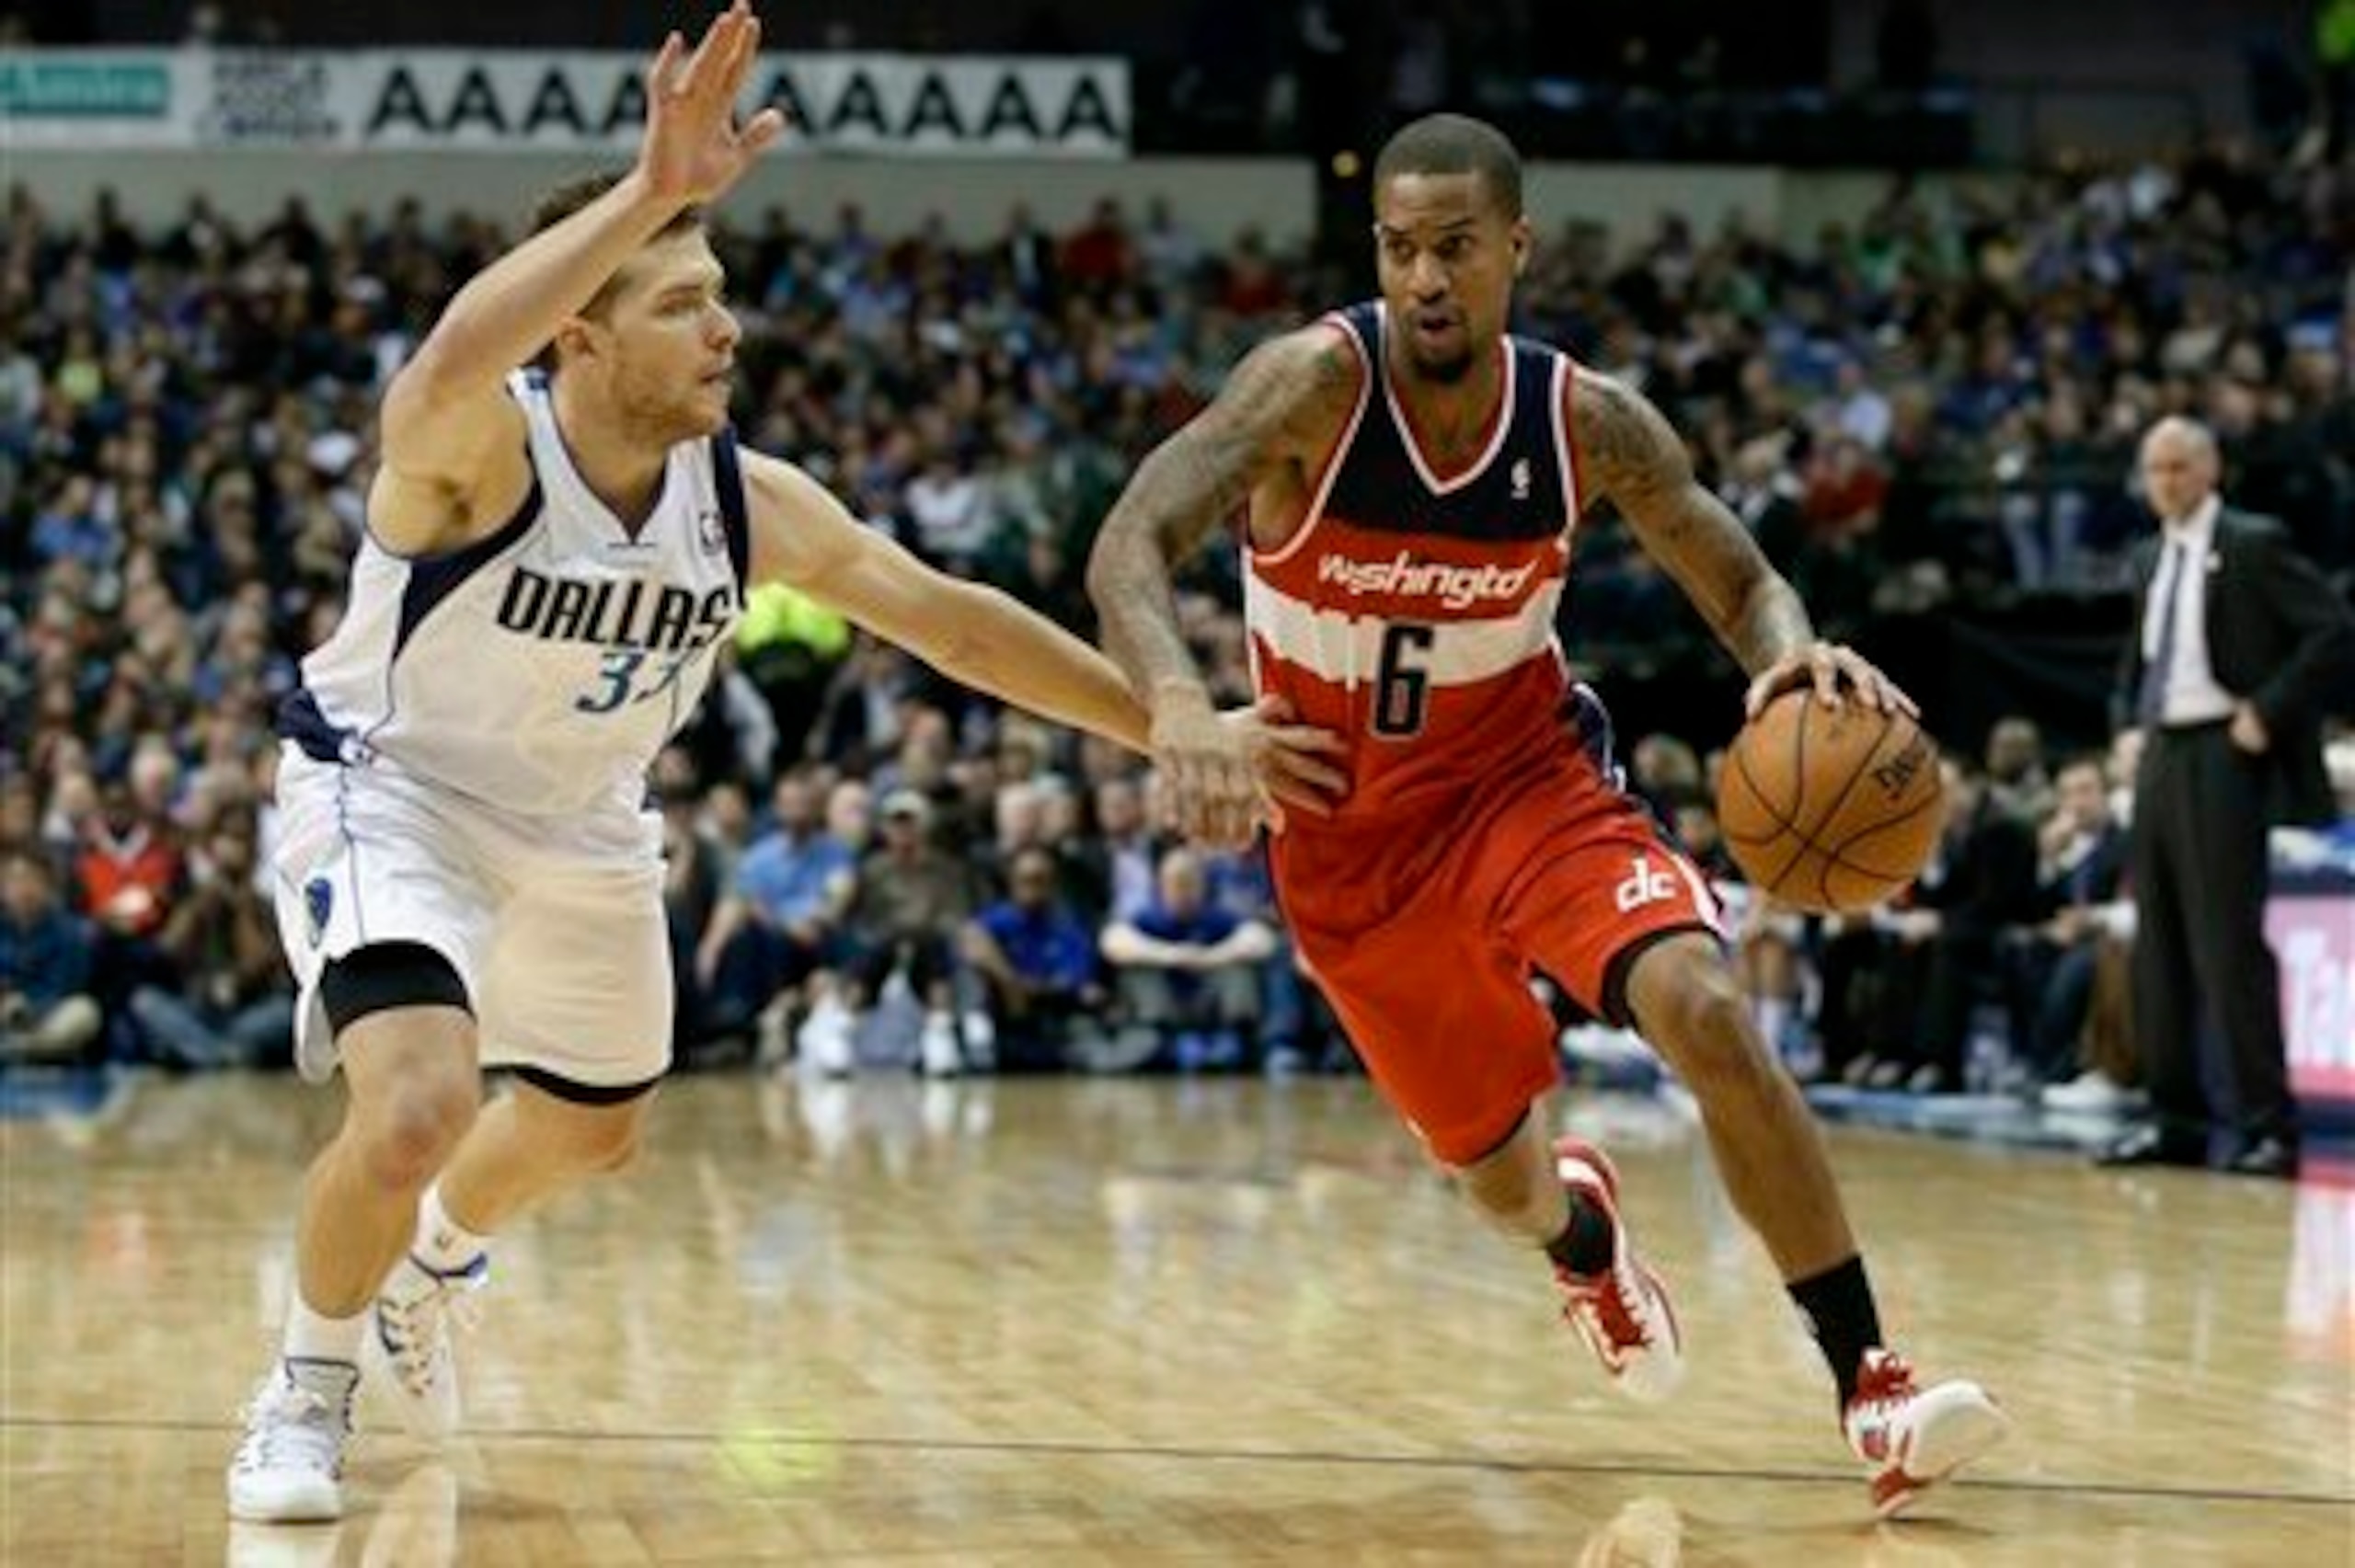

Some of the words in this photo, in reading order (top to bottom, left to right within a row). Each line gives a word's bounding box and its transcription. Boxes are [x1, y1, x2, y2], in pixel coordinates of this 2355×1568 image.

[497, 566, 733, 651] DALLAS
[1373, 624, 1434, 738] 6
[1616, 857, 1677, 913] dc
